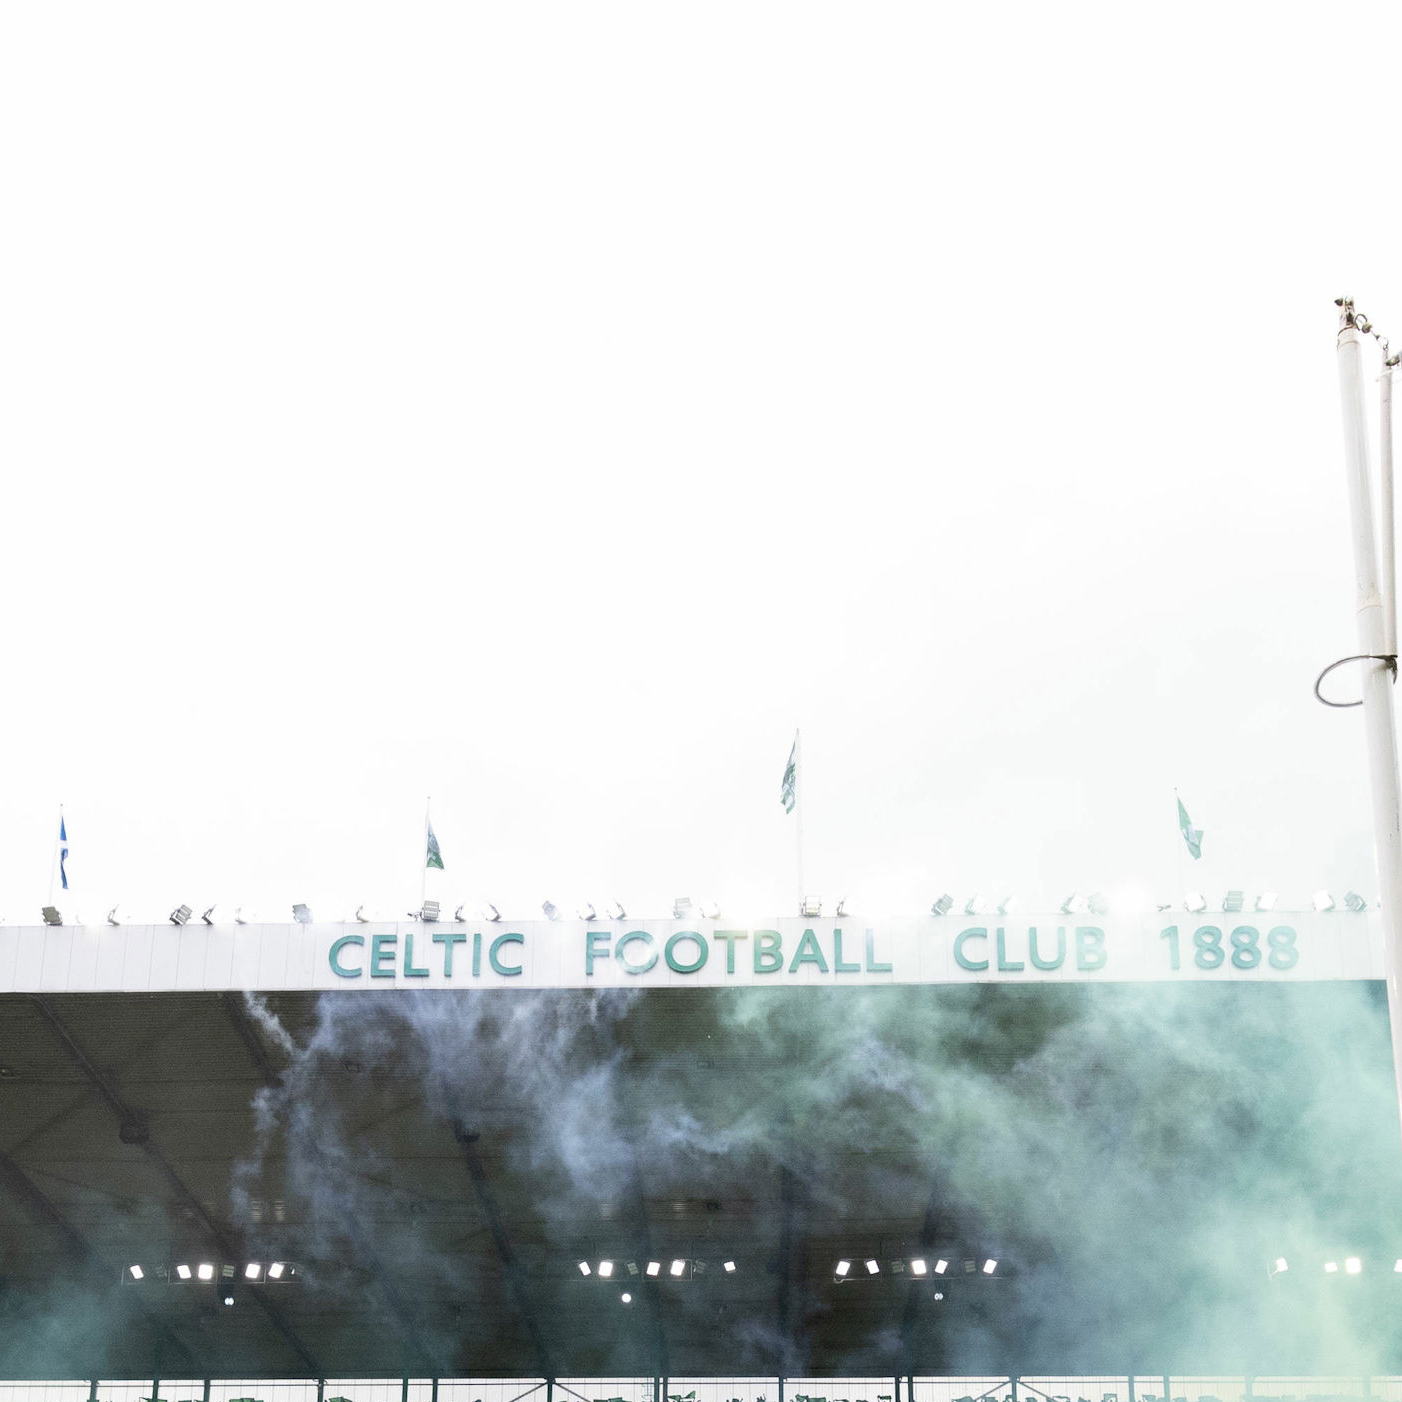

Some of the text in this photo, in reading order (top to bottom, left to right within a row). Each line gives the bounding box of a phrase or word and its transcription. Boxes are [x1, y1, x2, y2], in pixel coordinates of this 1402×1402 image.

[328, 924, 1300, 978] CELTIC FOOTBALL CLUB 1888
